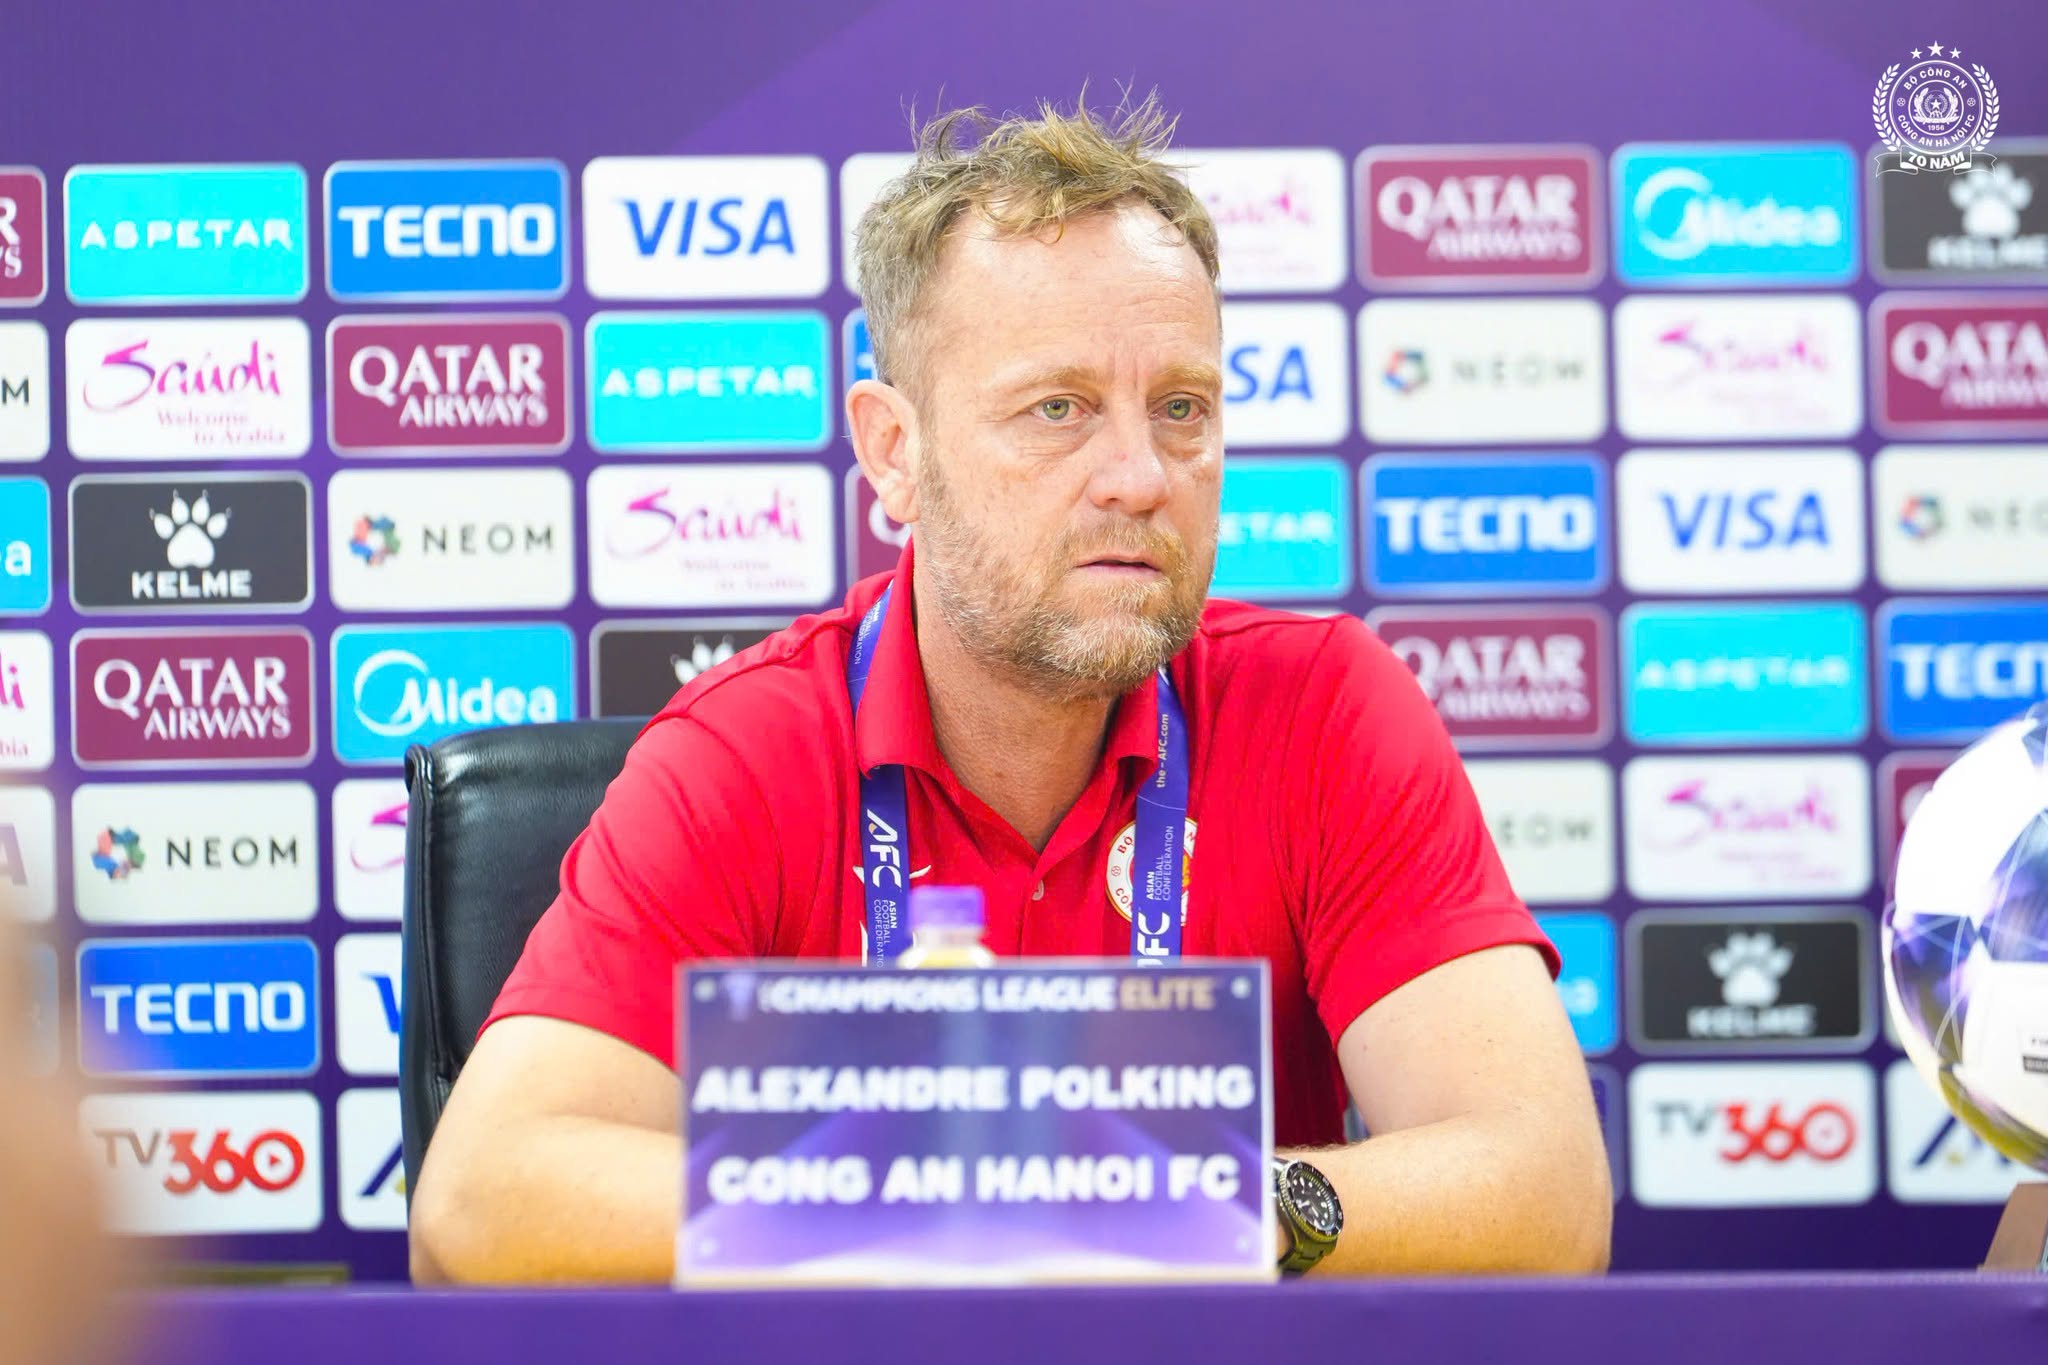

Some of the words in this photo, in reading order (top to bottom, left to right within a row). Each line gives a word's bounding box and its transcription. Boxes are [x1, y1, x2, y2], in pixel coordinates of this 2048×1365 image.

[337, 203, 556, 258] TECNO
[620, 197, 796, 257] VISA
[1377, 174, 1577, 240] QATAR
[80, 219, 293, 251] ASPETAR
[349, 343, 543, 407] QATAR
[1222, 345, 1313, 402] SA
[1891, 319, 2048, 389] QATA
[399, 393, 548, 428] AIRWAYS
[422, 523, 553, 554] NEOM
[1376, 496, 1595, 554] TECNO
[1659, 491, 1829, 551] VISA
[131, 569, 252, 599] KELME
[93, 657, 288, 720] QATAR
[1891, 641, 2048, 700] TECN
[144, 705, 292, 740] AIRWAYS
[165, 837, 300, 867] NEOM
[867, 808, 902, 889] AFC
[1163, 826, 1174, 901] CONFEDERATION
[1146, 871, 1155, 900] ASIAN
[1154, 856, 1164, 901] FOOTBALL
[873, 899, 885, 968] CONFEDERATIO
[882, 899, 891, 944] FOOTBALL
[889, 900, 898, 929] ASIAN
[91, 981, 305, 1034] TECNO
[1119, 974, 1215, 1009] ELITE
[693, 1066, 1006, 1112] ALEXANDRE
[1019, 1065, 1255, 1109] POLKING
[93, 1127, 305, 1194] TV360
[1655, 1101, 1857, 1165] TV360
[706, 1156, 873, 1204] CONG
[880, 1156, 964, 1203] AN
[974, 1155, 1153, 1203] HANOI
[1166, 1155, 1240, 1201] FC
